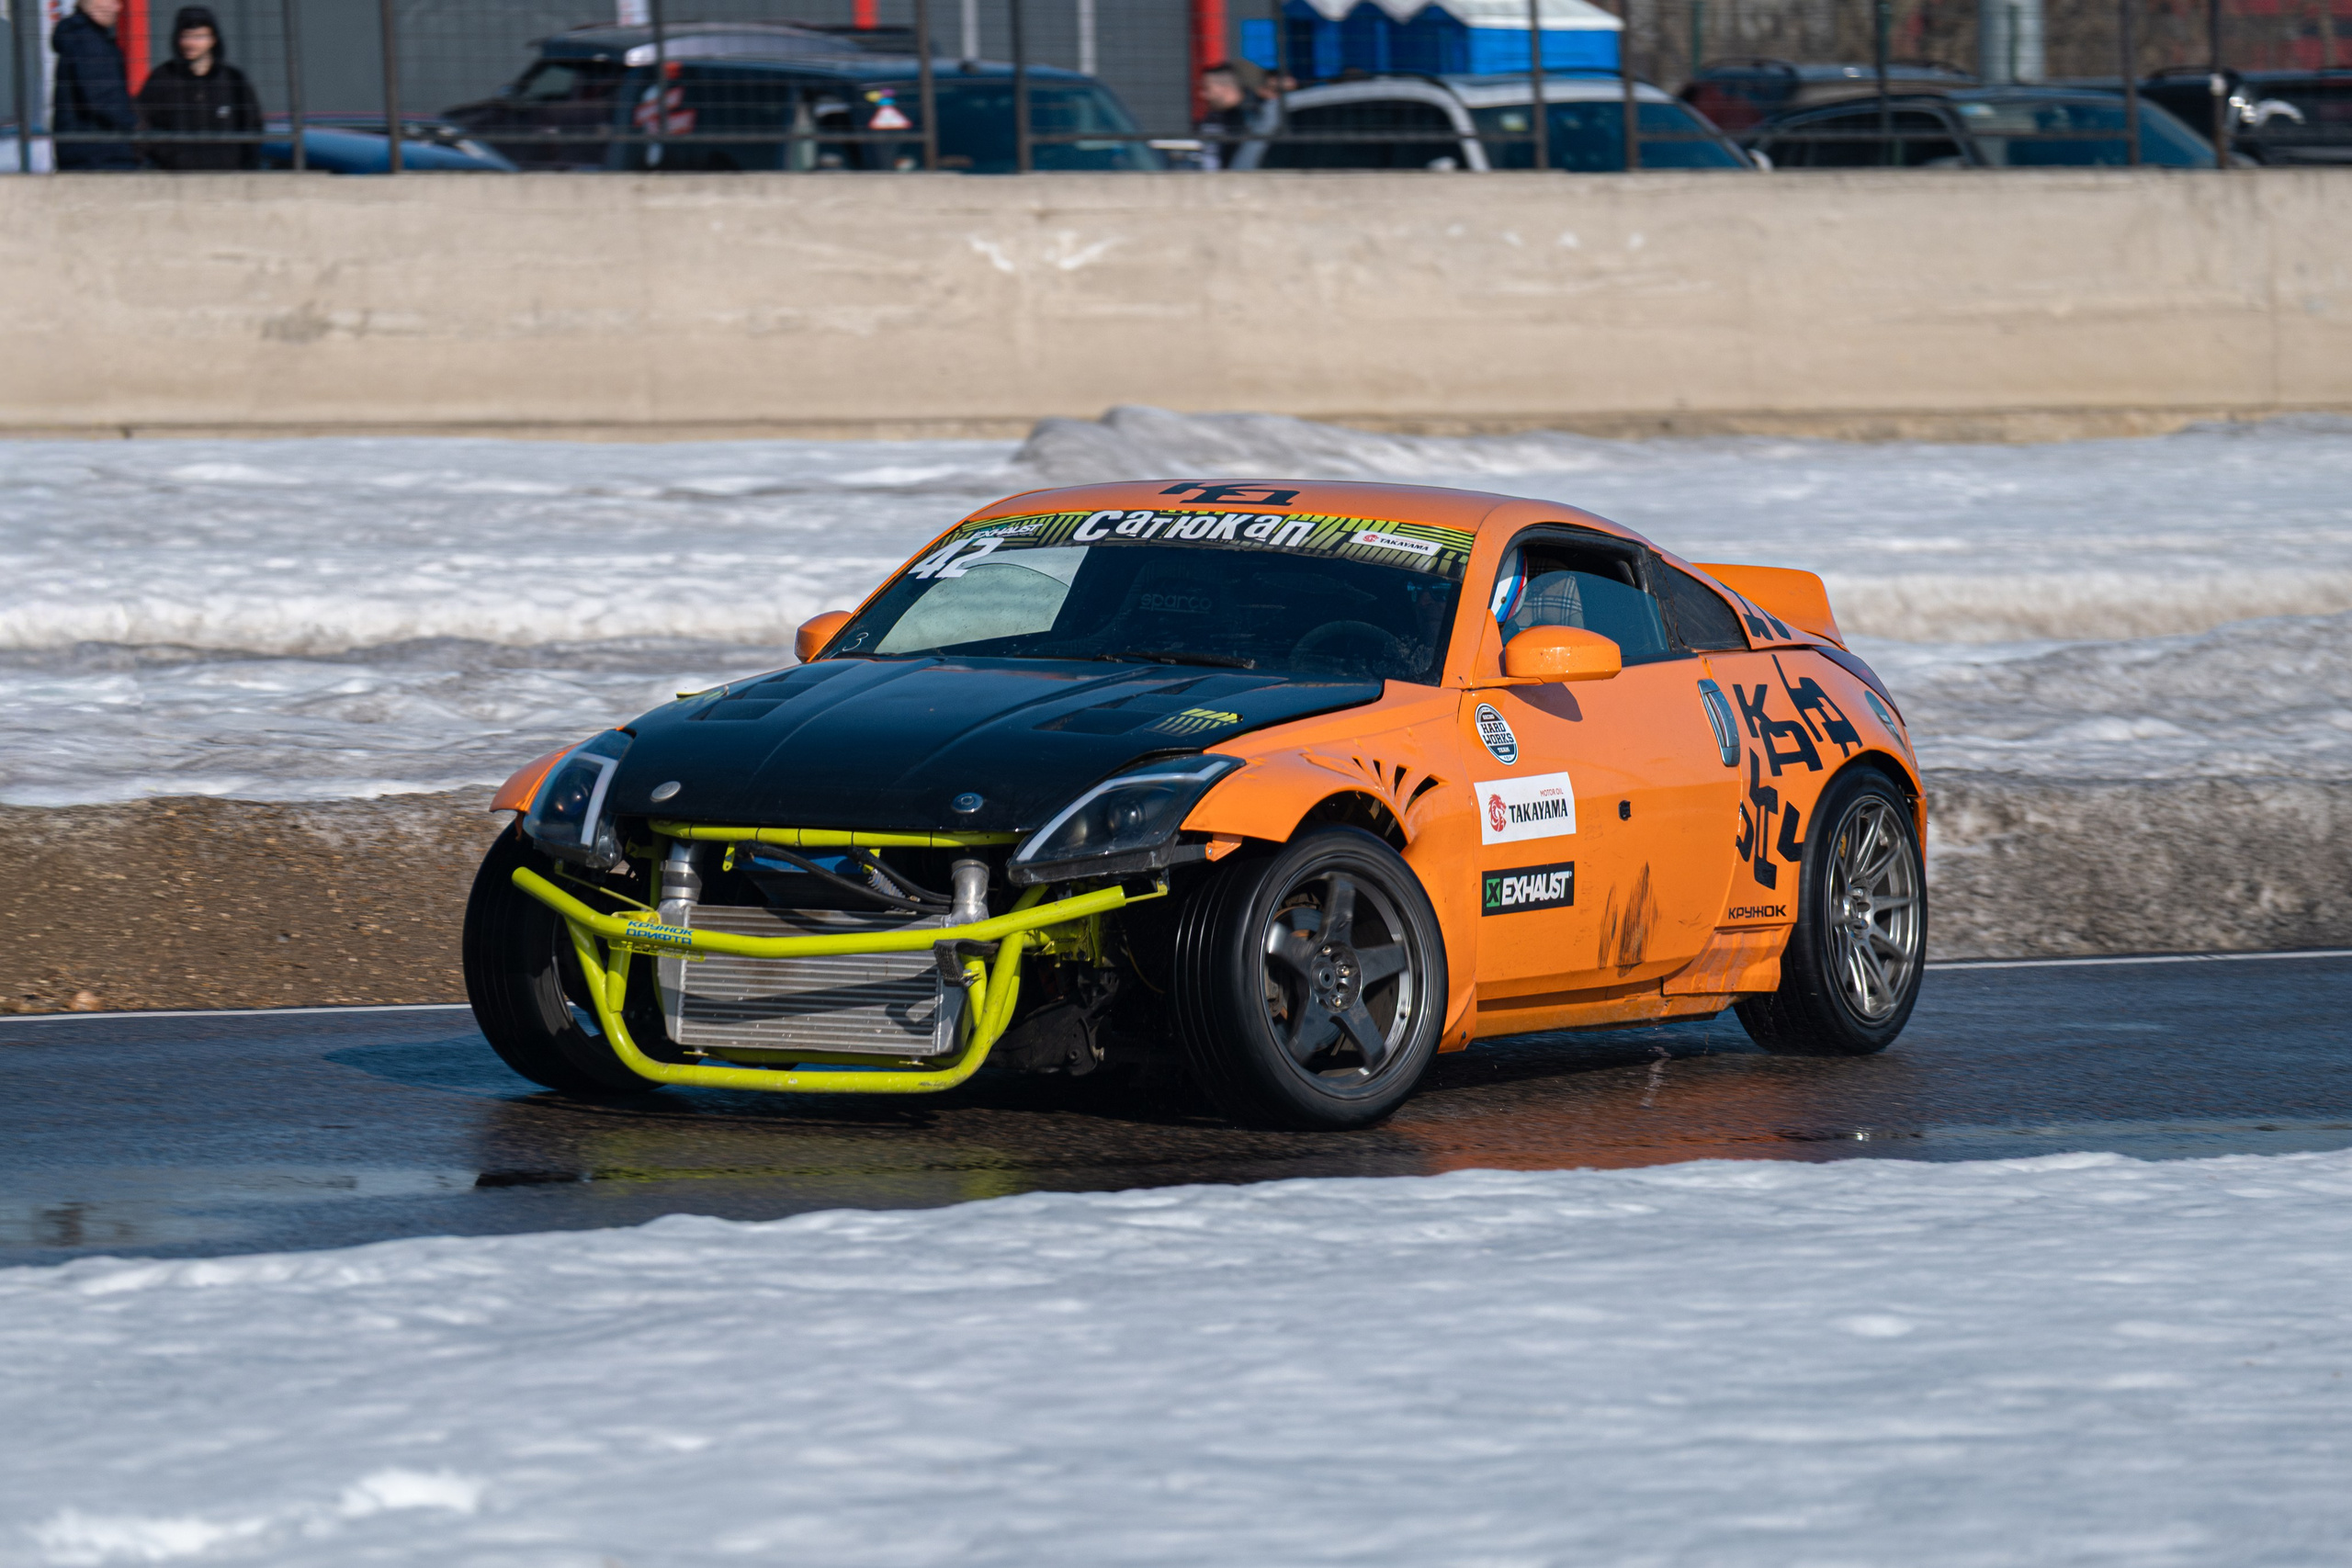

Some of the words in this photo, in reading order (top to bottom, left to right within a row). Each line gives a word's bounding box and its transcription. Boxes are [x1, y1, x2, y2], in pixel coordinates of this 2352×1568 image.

[972, 523, 1044, 539] EXHAUST
[1380, 538, 1429, 551] TAKAYAMA
[908, 537, 1005, 580] 42
[1140, 593, 1212, 611] sparco
[1480, 722, 1507, 734] HARD
[1482, 733, 1515, 745] WORKS
[1540, 789, 1555, 797] MOTOR
[1508, 798, 1568, 824] TAKAYAMA
[1728, 904, 1787, 919] КРУЖОК
[628, 920, 694, 936] КРУЖОК
[626, 928, 692, 945] ДРИФТА
